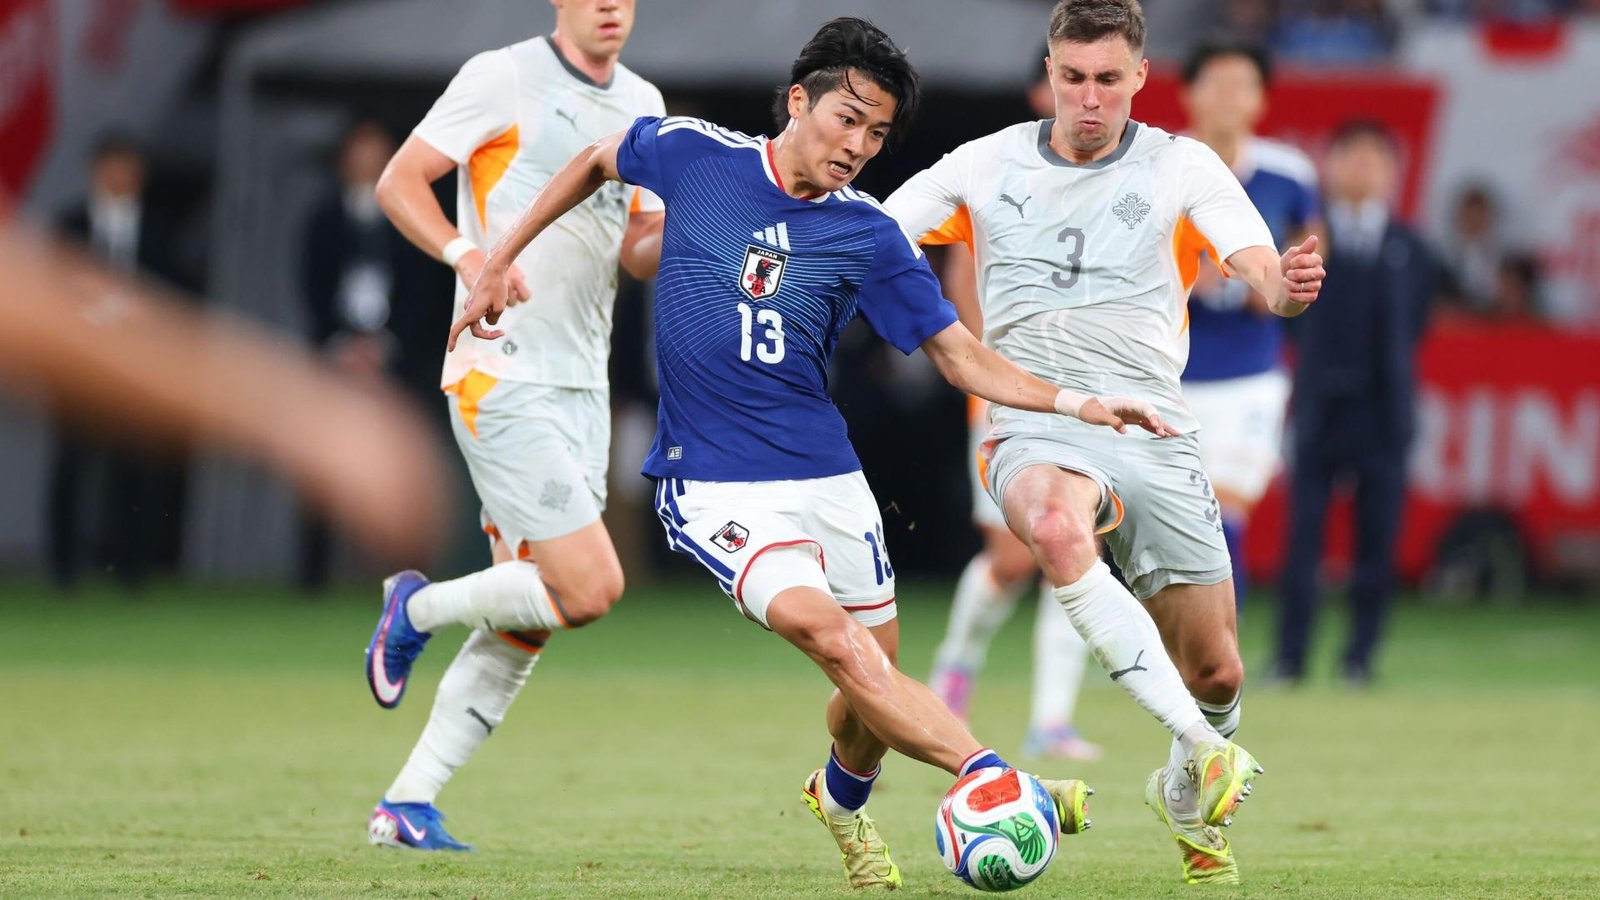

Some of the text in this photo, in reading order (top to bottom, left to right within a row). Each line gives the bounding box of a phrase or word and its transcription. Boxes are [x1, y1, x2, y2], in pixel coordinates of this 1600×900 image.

[757, 249, 778, 259] JAPAN
[1051, 227, 1085, 289] 3
[748, 282, 766, 294] JFA
[737, 302, 785, 364] 13
[864, 521, 893, 586] 13
